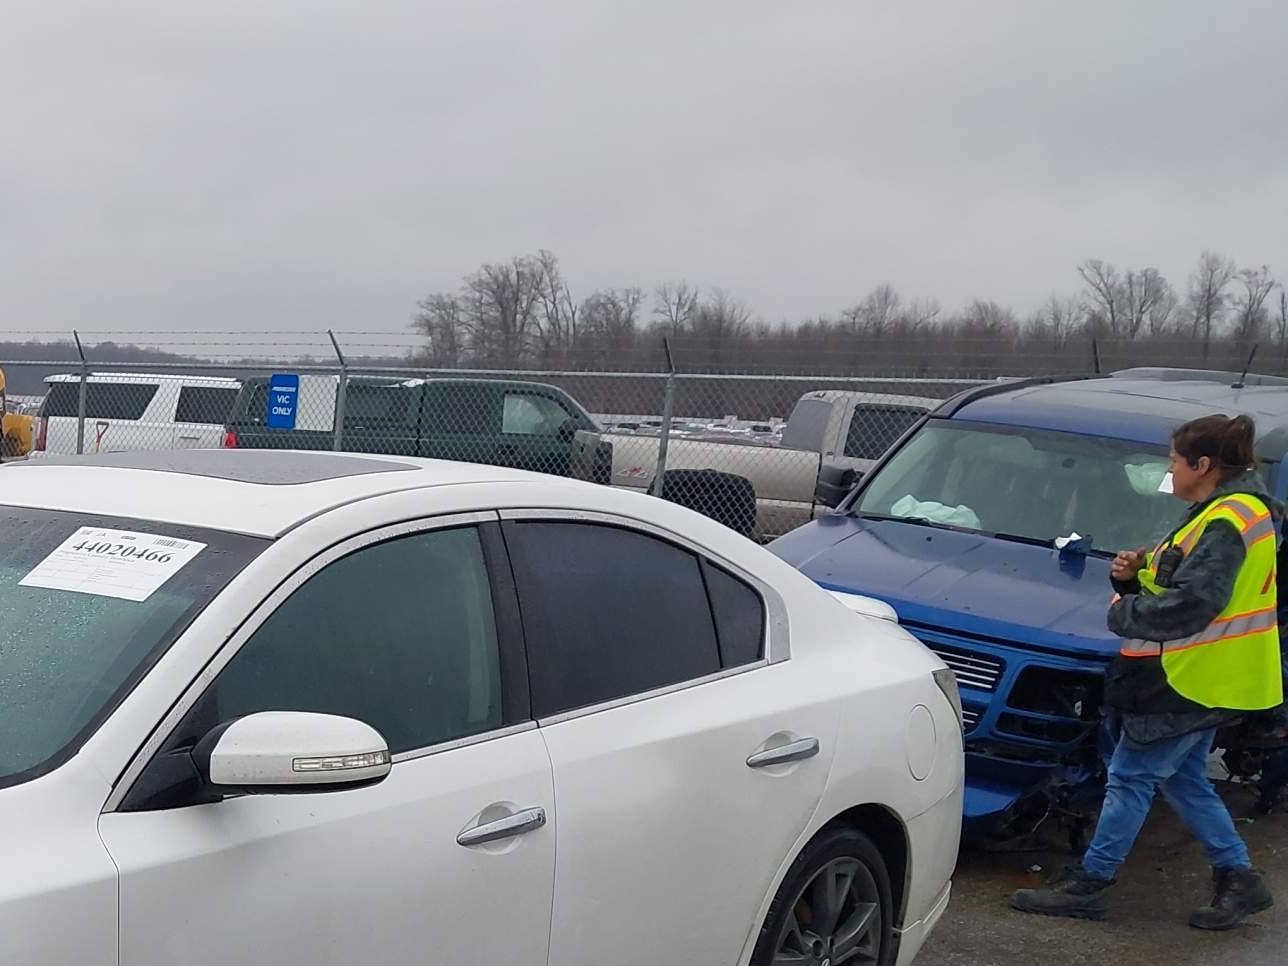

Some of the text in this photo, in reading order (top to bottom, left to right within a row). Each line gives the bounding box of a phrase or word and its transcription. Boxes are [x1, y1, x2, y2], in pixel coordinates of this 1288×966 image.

[277, 395, 290, 404] VIC
[272, 406, 293, 416] ONLY
[72, 540, 176, 563] 44020466
